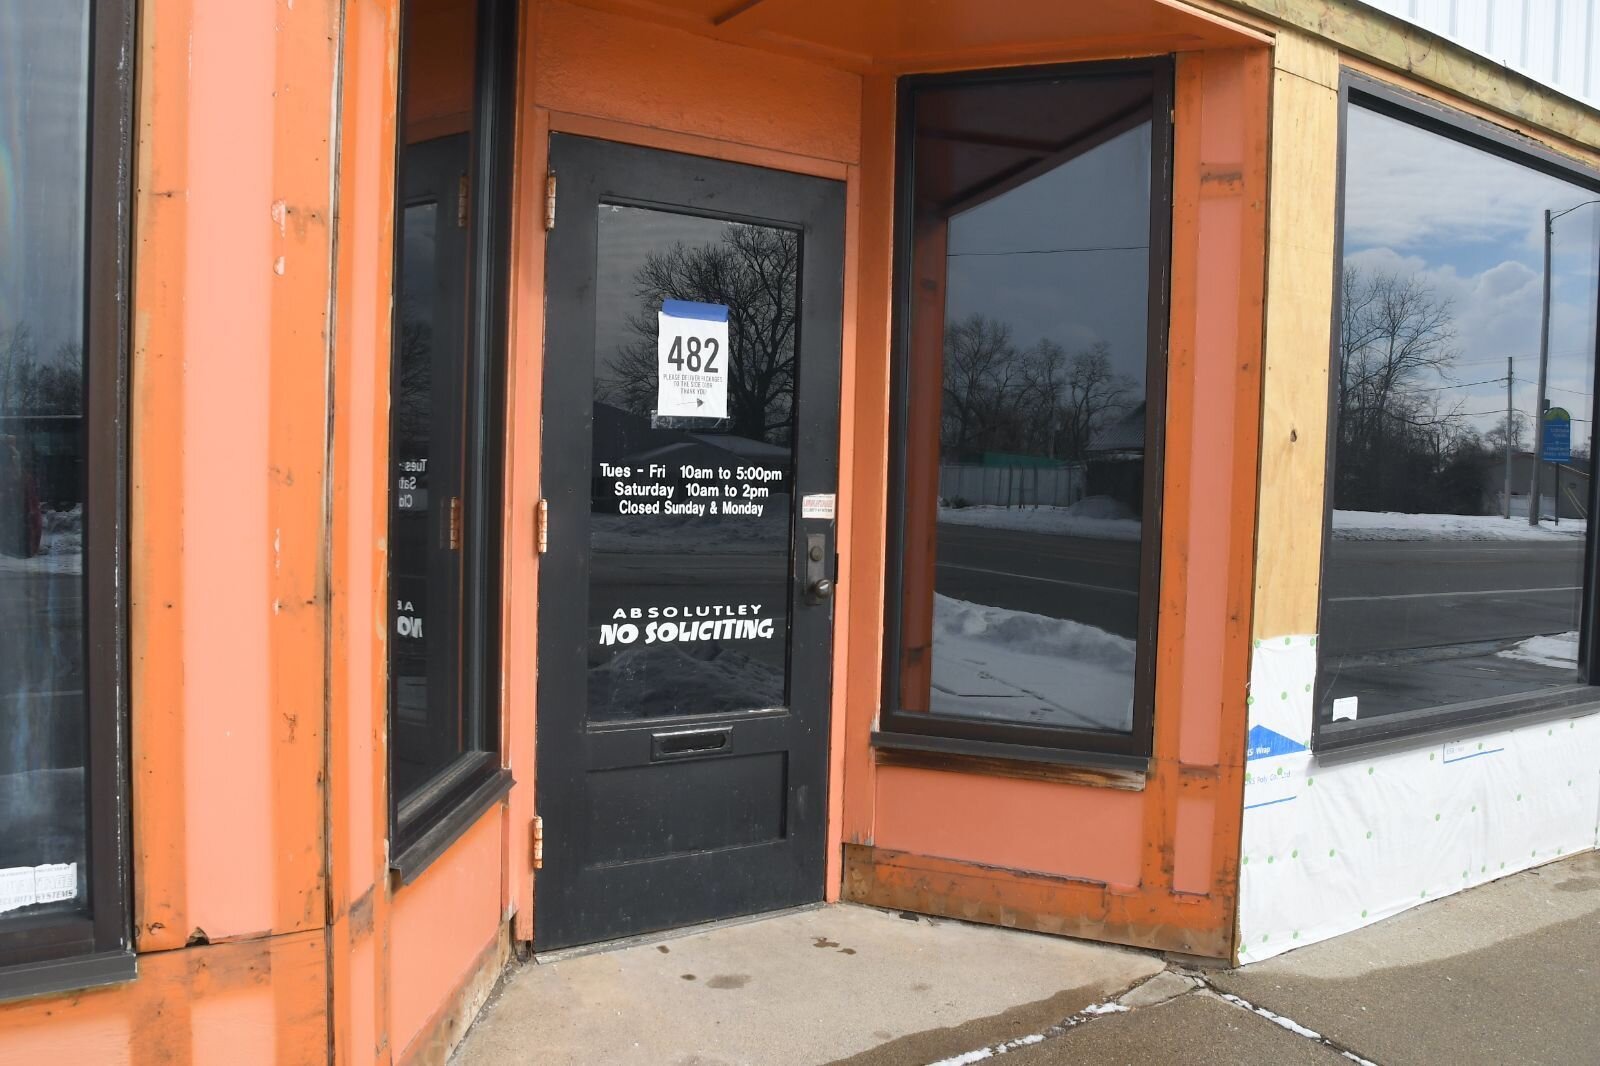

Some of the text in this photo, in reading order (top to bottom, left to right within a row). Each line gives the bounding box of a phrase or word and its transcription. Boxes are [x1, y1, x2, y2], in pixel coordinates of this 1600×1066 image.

[668, 336, 719, 373] 482
[682, 374, 701, 382] DELIVER
[600, 463, 631, 477] Tues
[650, 464, 666, 478] Fri
[680, 465, 713, 479] 10am
[718, 467, 731, 479] to
[736, 467, 782, 482] 5:00pm
[614, 482, 769, 500] Saturday 10am to 2pm
[619, 500, 764, 517] Closed Sunday & Monday
[613, 604, 762, 619] ABSOLUTLEY
[600, 618, 774, 645] NO SOLICITING
